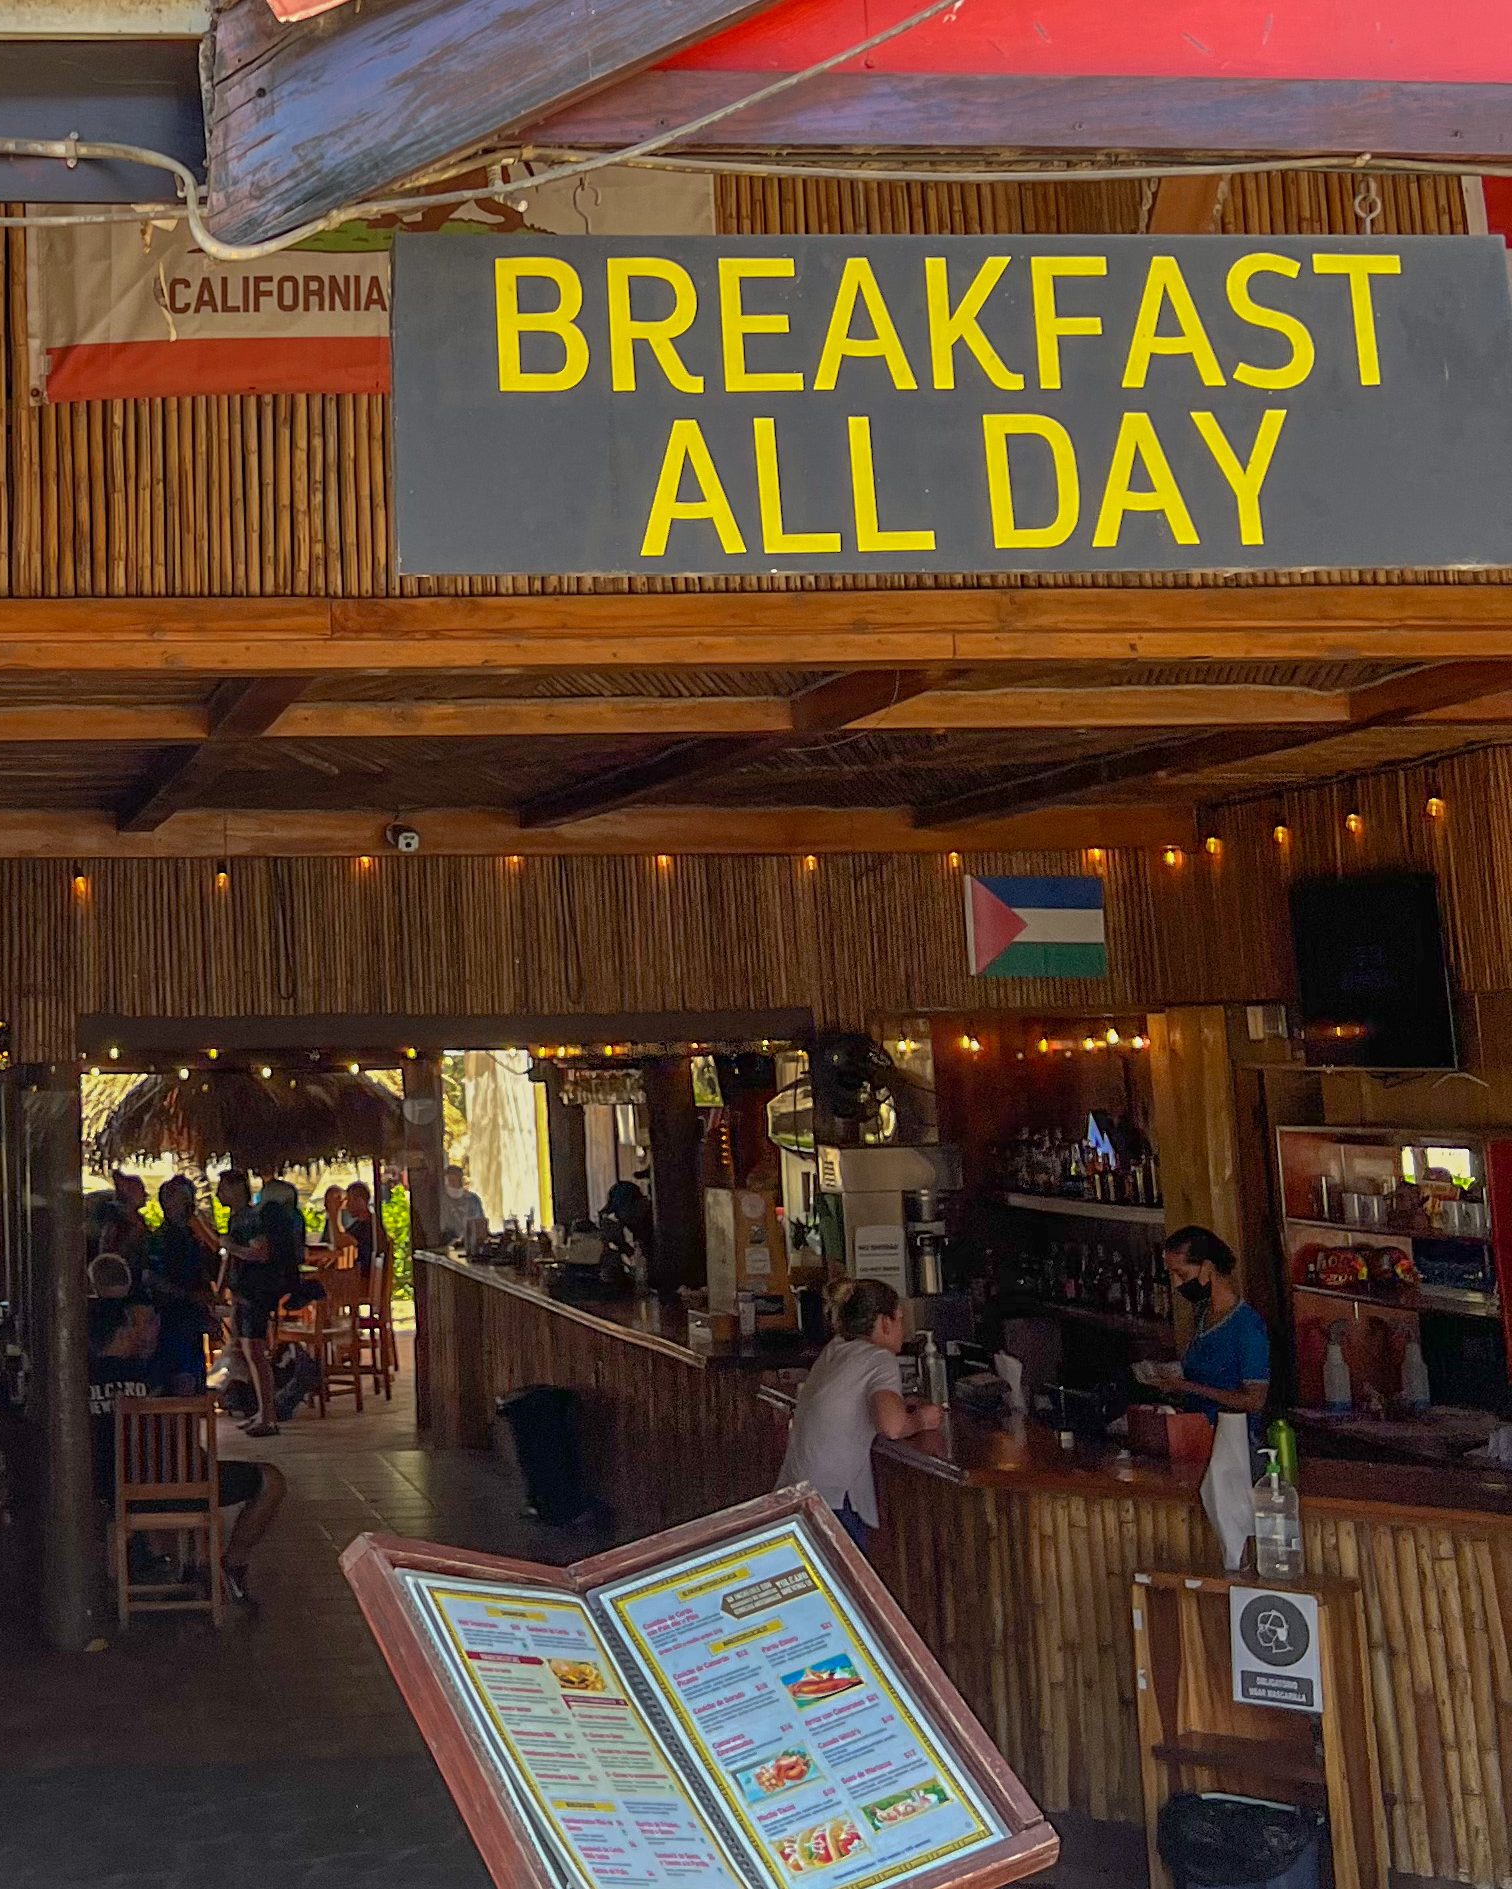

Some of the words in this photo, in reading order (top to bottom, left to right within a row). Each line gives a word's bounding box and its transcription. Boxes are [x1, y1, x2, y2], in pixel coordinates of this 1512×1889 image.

[169, 274, 387, 315] CALIFORNIA
[493, 251, 1402, 395] BREAKFAST
[640, 416, 937, 558] ALL
[980, 408, 1288, 551] DAY
